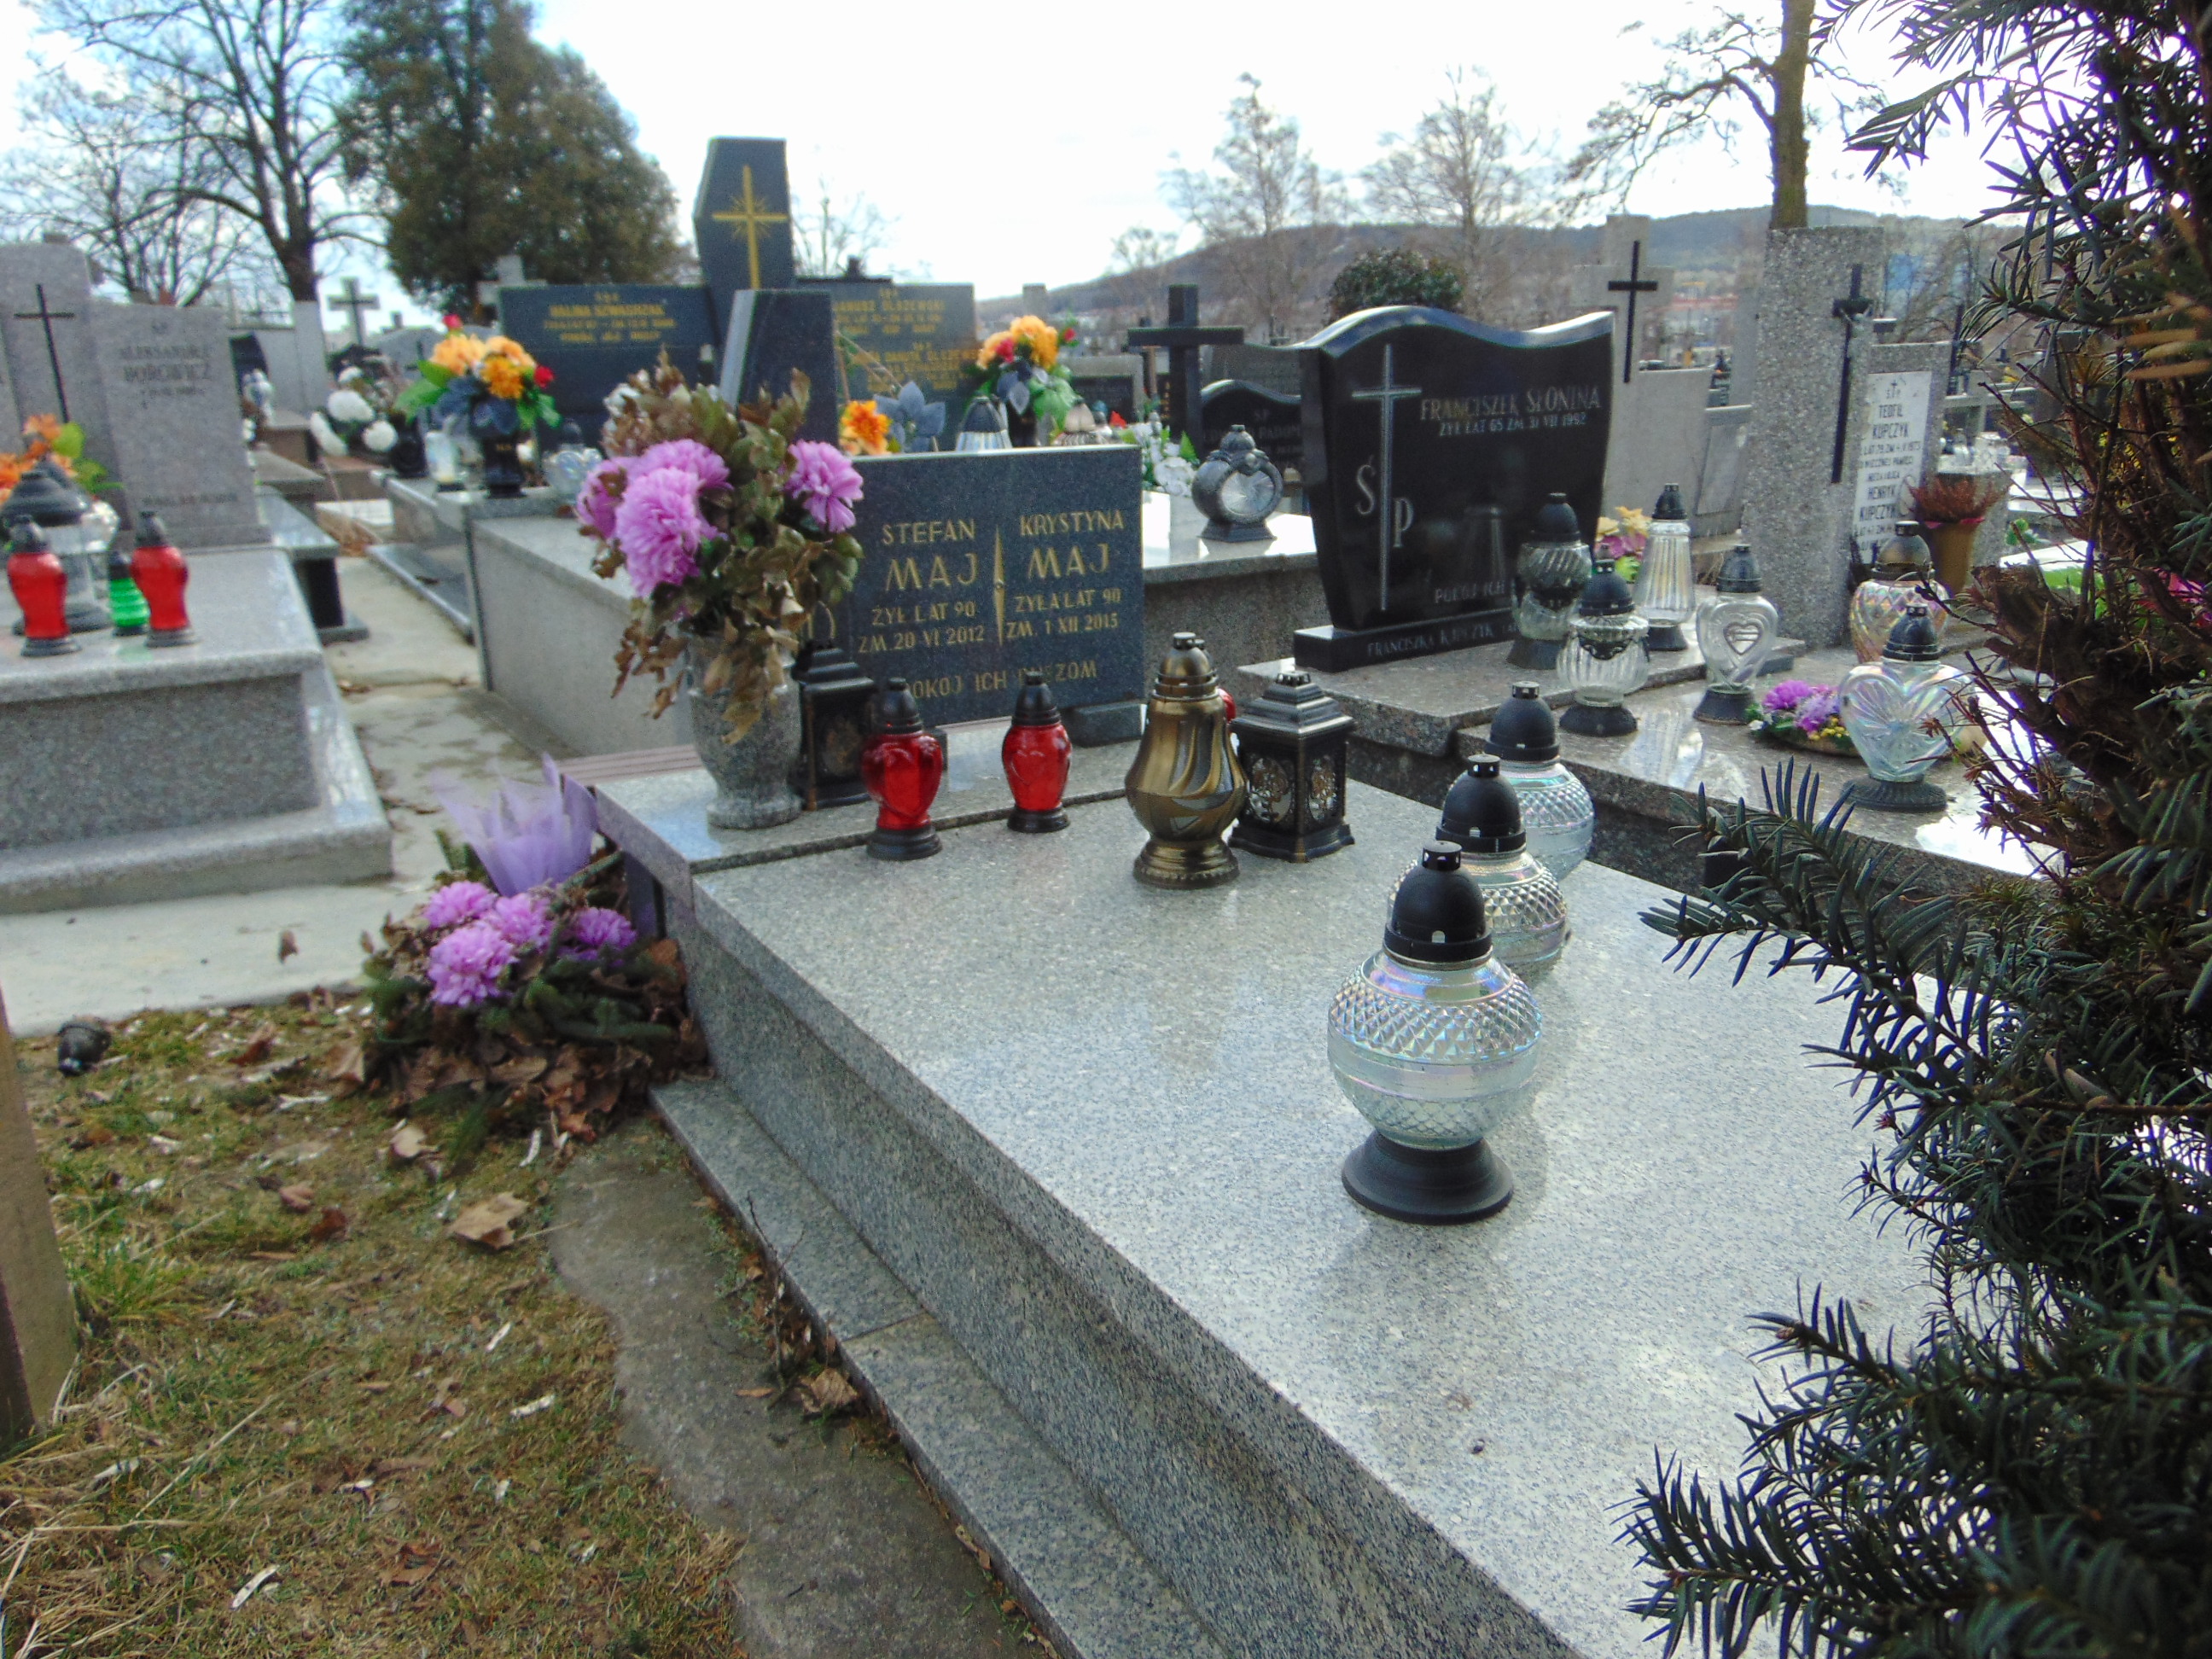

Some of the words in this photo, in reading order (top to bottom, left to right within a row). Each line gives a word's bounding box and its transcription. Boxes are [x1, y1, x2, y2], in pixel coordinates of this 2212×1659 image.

[882, 519, 975, 545] STEFAN
[1020, 509, 1125, 536] KRYSTYNA
[885, 553, 979, 591] MAJ
[1027, 543, 1110, 580] MAJ
[1064, 589, 1095, 608] LAT
[1102, 588, 1121, 604] 90
[915, 602, 948, 622] LAT
[954, 601, 977, 618] 90
[1058, 615, 1079, 633] XII
[1084, 612, 1118, 632] 2015
[946, 625, 985, 645] 2012
[908, 675, 963, 699] OKOJ
[975, 670, 1007, 692] ICH
